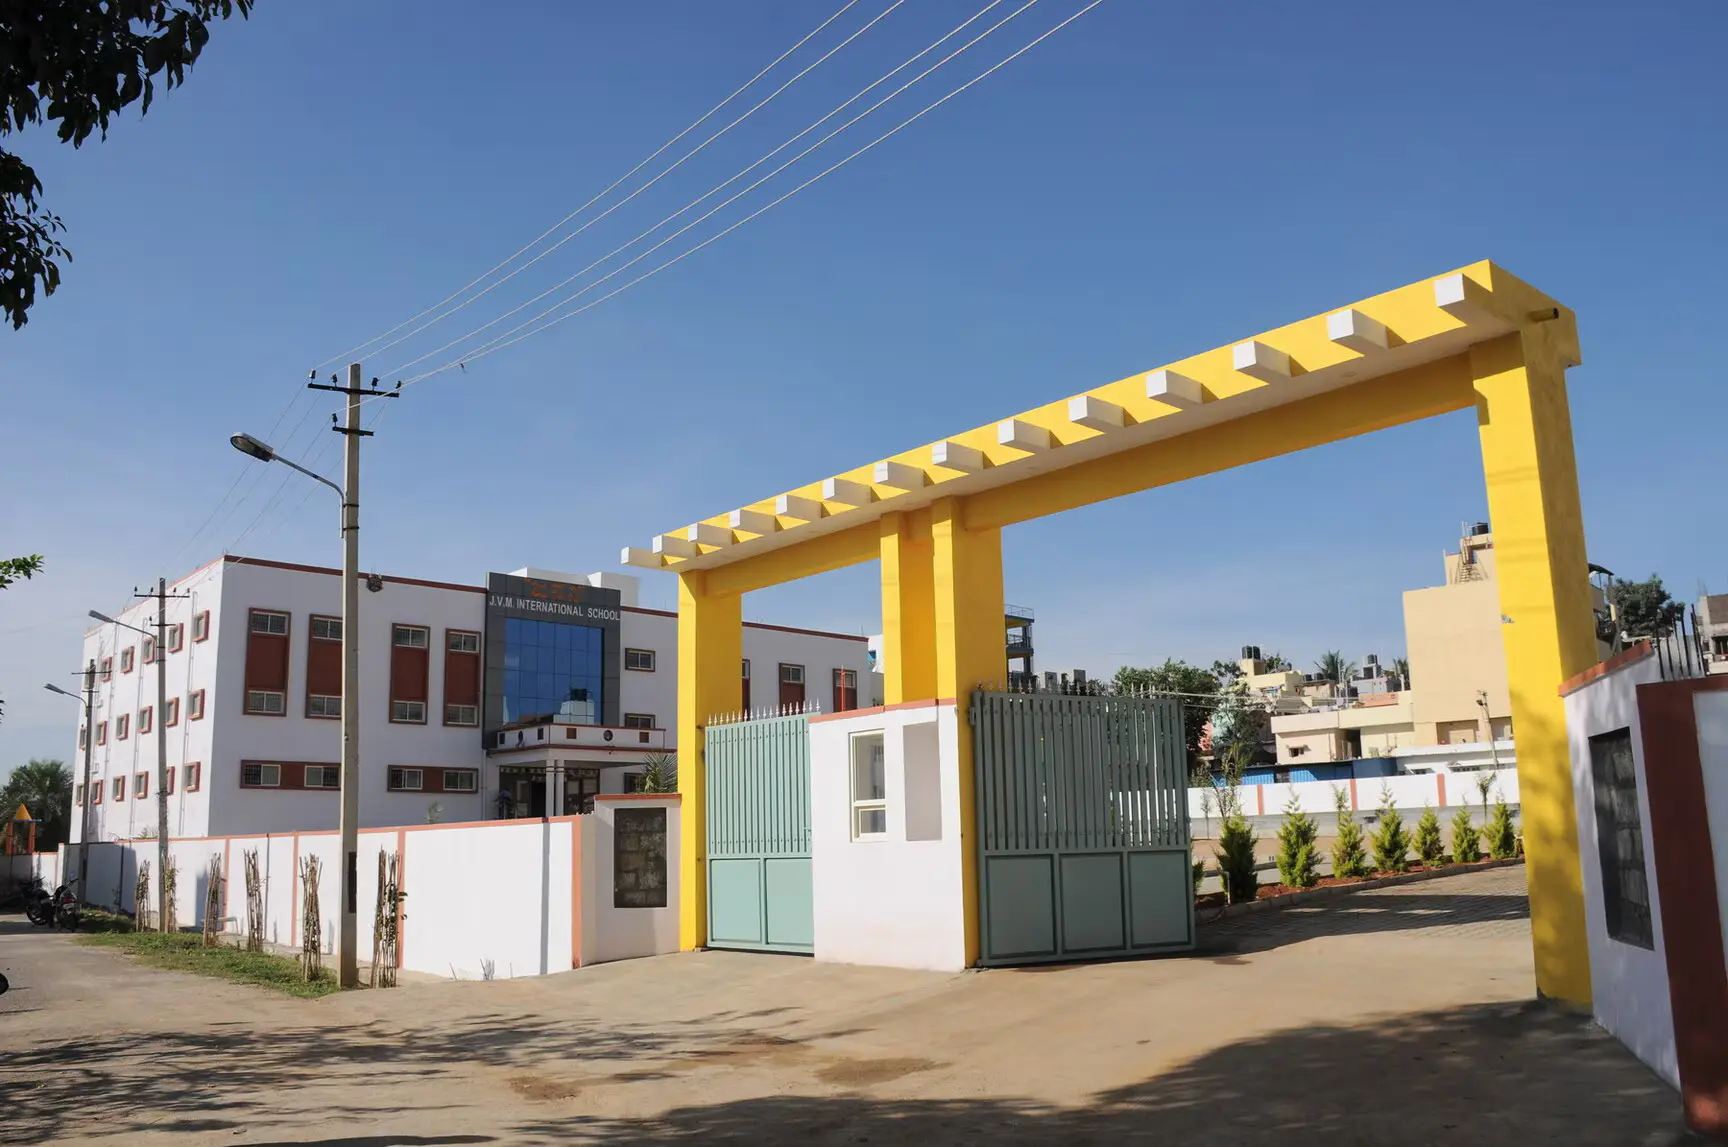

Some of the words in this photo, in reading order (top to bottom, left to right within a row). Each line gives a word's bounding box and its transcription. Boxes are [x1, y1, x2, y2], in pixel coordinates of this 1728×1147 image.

[489, 595, 515, 608] J.V.M.
[516, 598, 583, 616] INTERNATIONAL
[587, 608, 620, 620] SCHOOL
